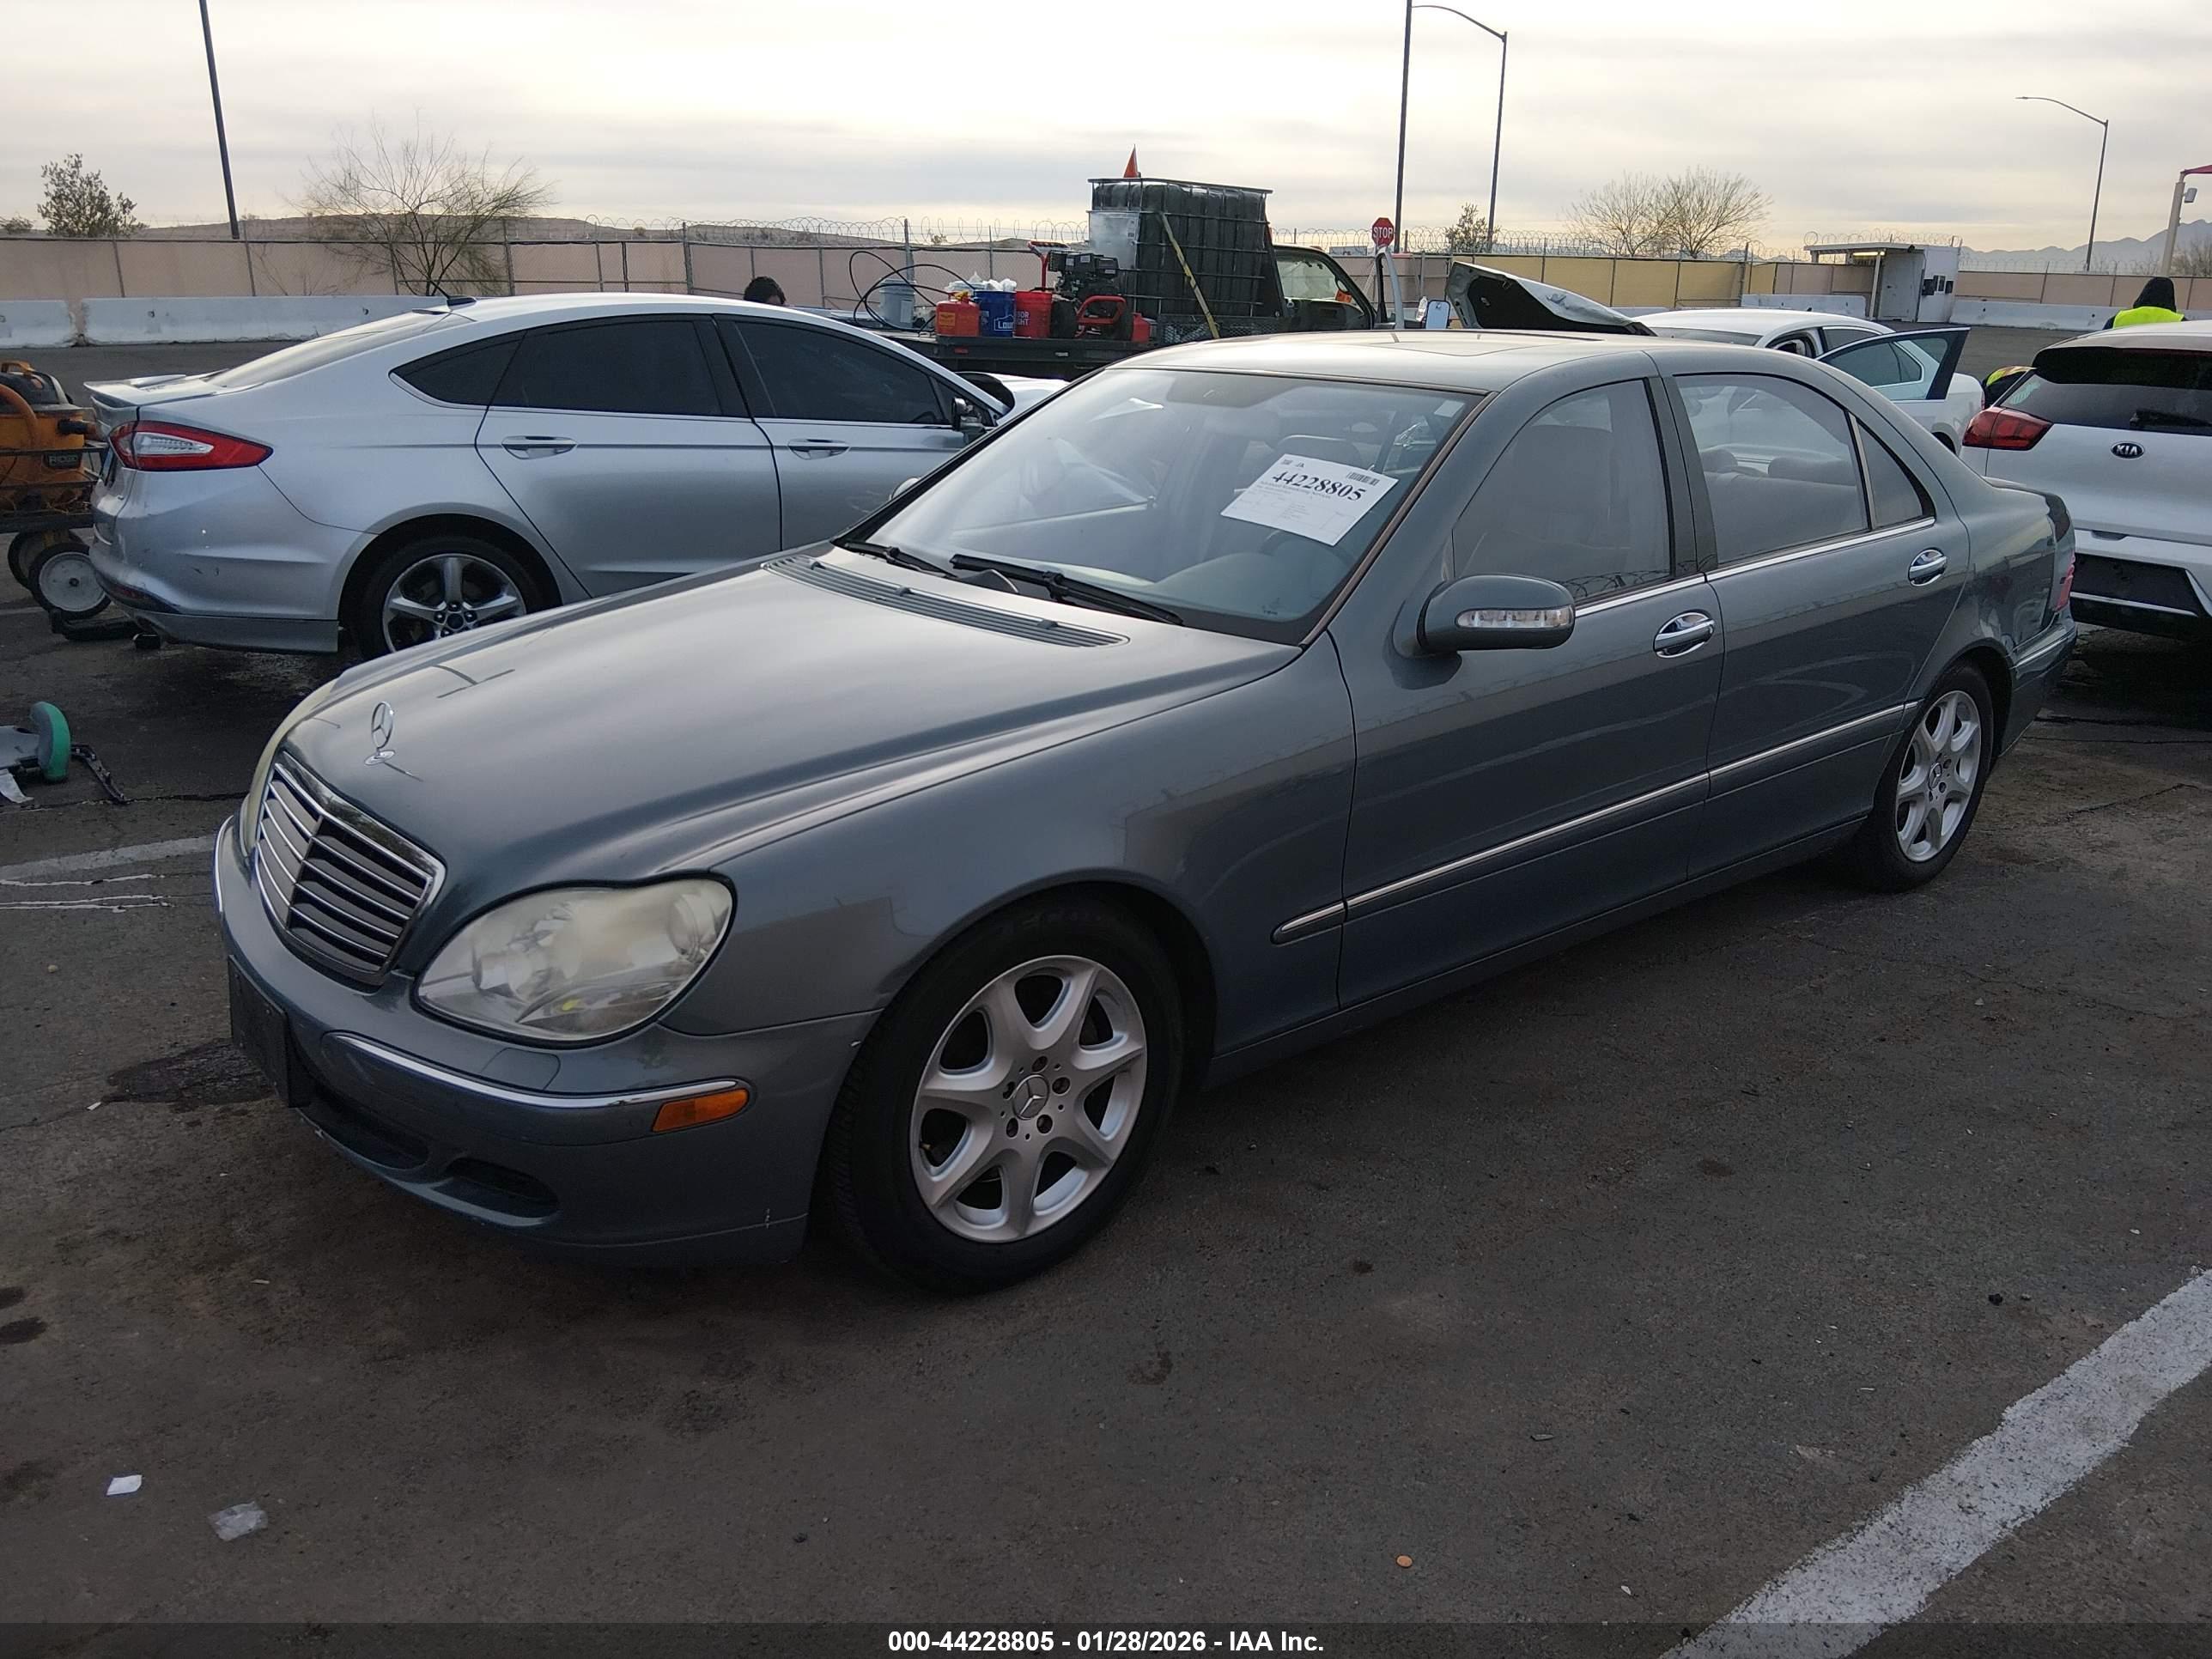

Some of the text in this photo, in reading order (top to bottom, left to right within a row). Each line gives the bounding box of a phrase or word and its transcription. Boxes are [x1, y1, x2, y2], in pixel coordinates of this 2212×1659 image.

[1373, 226, 1393, 239] STOP
[2116, 444, 2138, 456] KIA
[1272, 471, 1367, 501] 44228805
